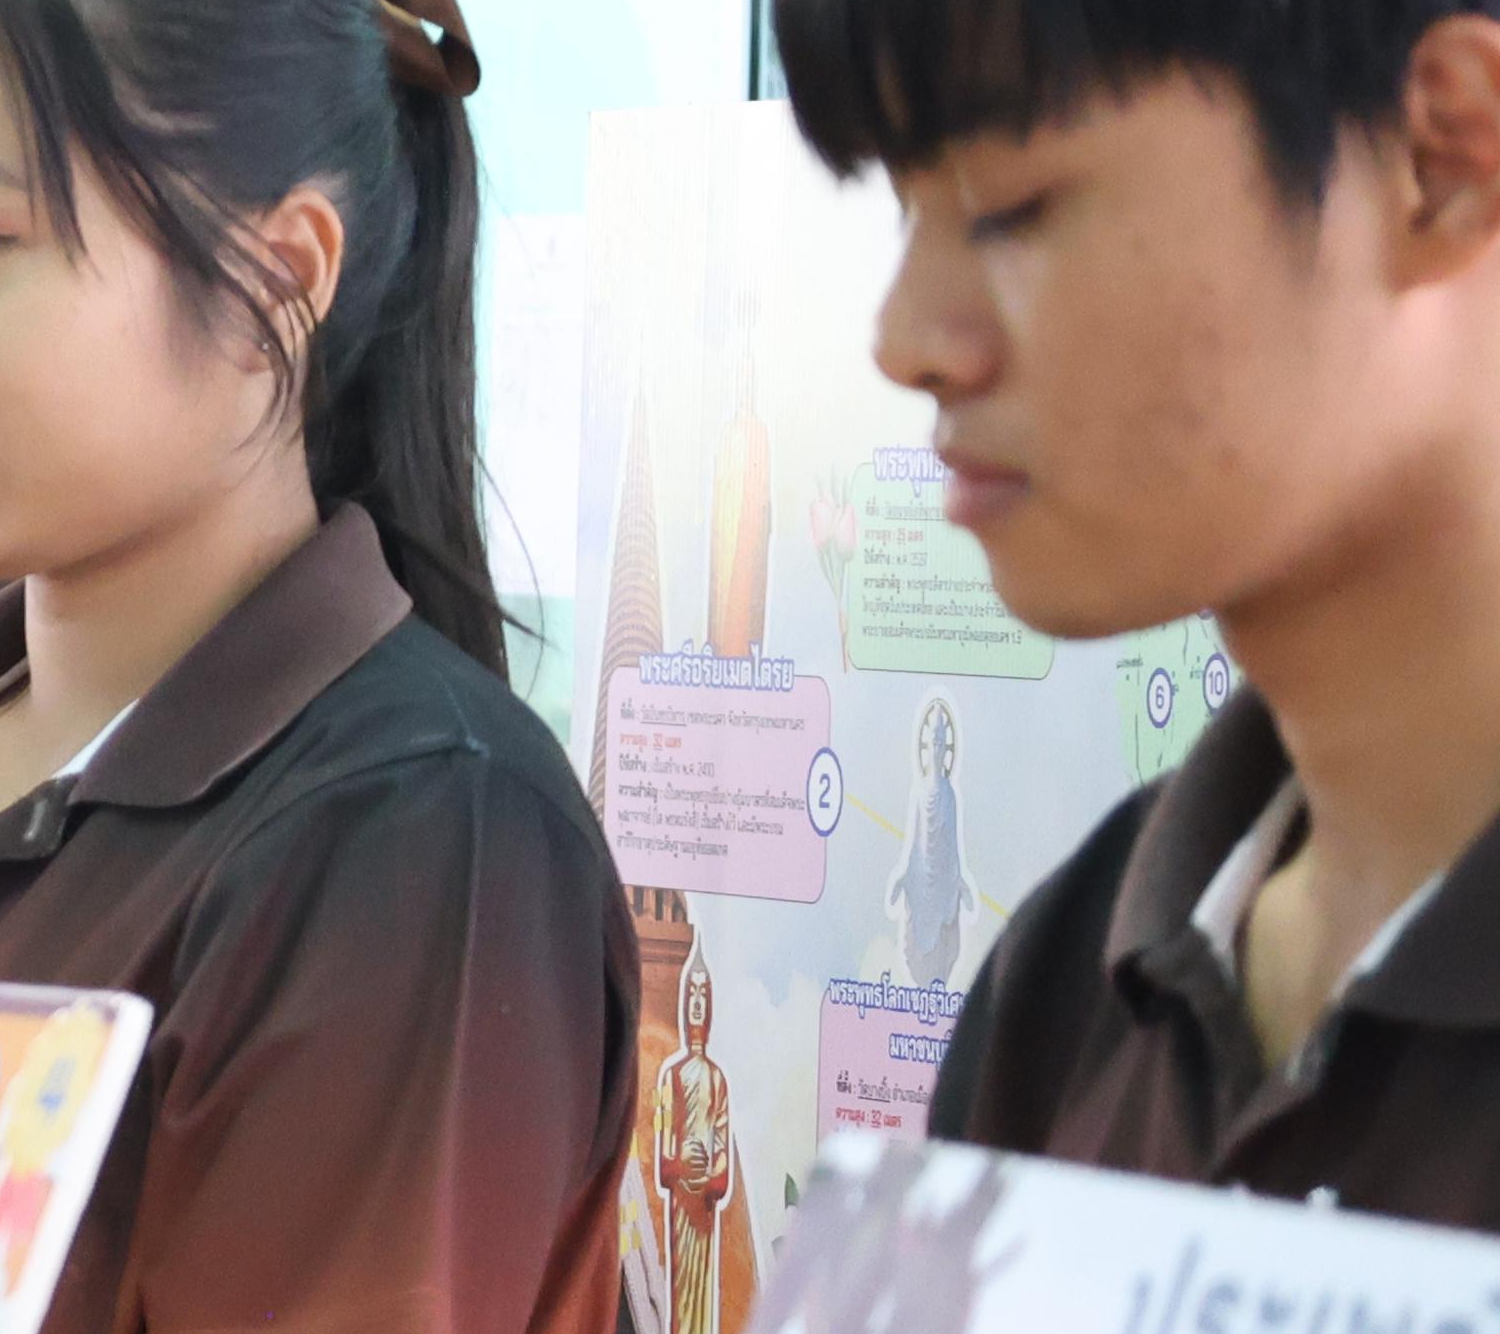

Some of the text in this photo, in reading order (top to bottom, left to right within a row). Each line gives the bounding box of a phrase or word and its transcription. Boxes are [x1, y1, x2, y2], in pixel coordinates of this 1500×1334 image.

[1155, 685, 1166, 710] 6
[1208, 670, 1225, 698] 10
[818, 773, 831, 809] 2
